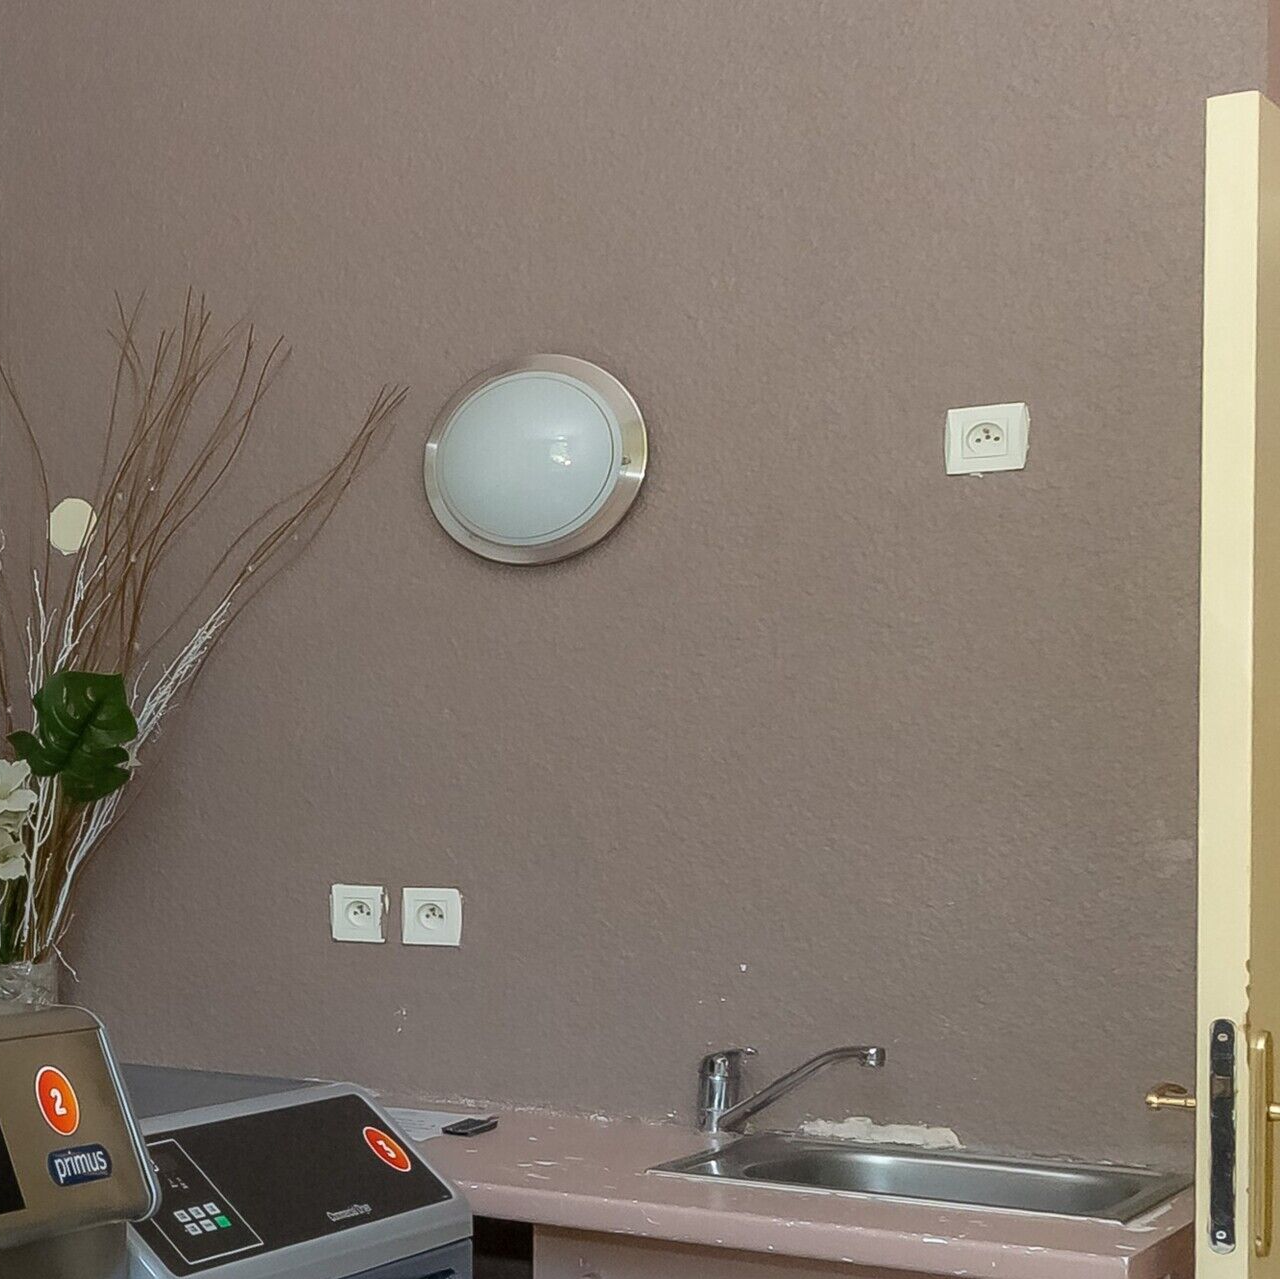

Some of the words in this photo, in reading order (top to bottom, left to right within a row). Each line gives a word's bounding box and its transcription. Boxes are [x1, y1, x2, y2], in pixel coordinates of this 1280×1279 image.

[49, 1088, 67, 1116] 2
[376, 1140, 397, 1159] 3
[54, 1150, 108, 1184] primus
